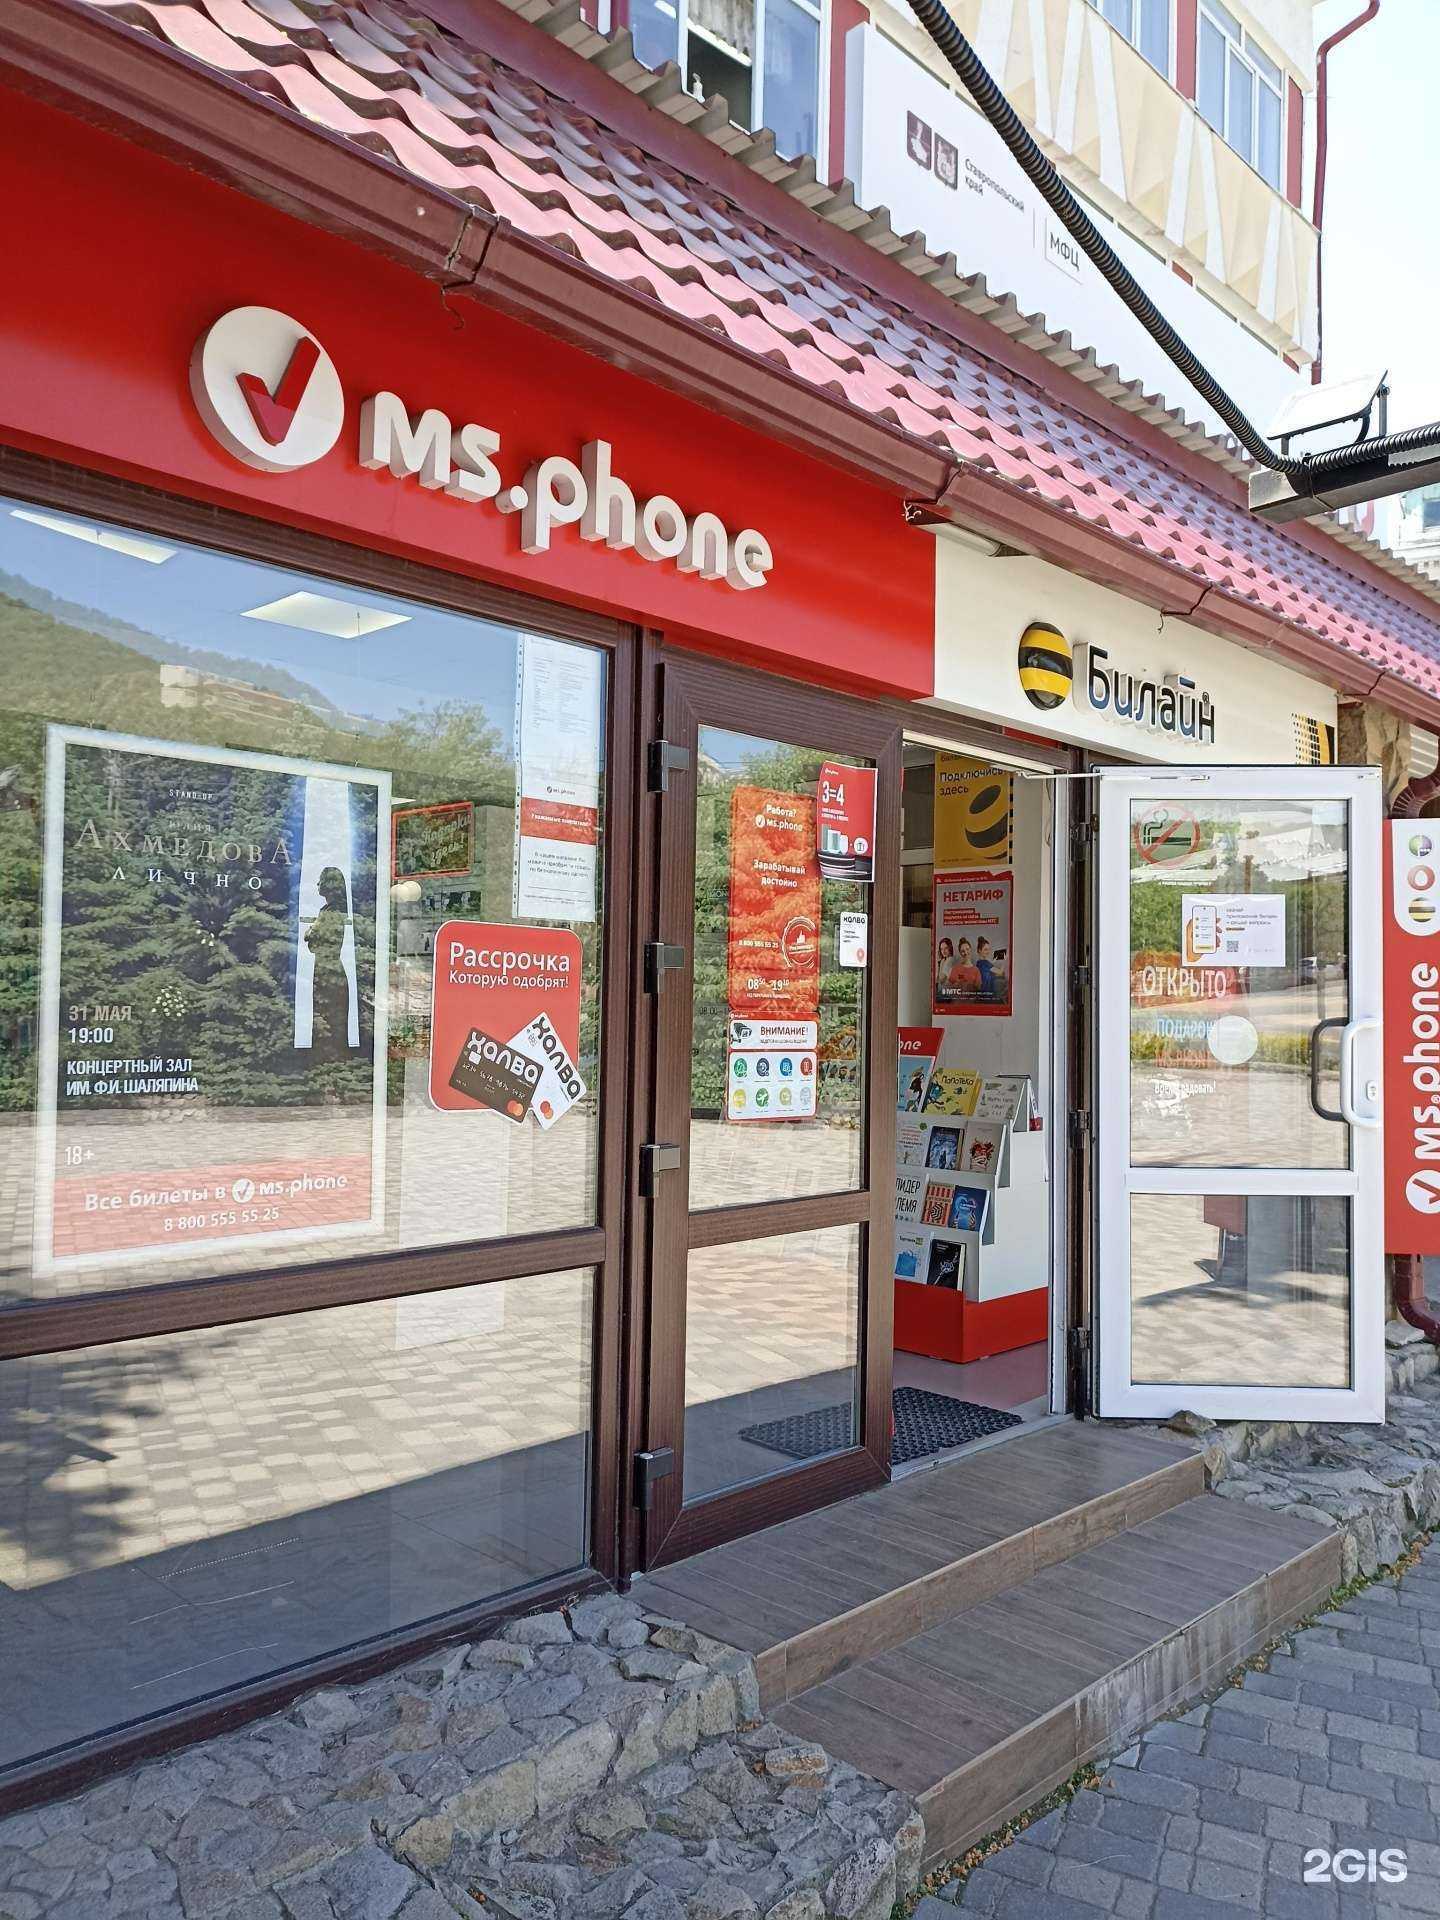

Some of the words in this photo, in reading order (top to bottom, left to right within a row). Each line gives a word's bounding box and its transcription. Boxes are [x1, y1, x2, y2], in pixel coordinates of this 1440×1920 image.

[1049, 232, 1080, 271] МФЦ
[169, 788, 213, 801] STAND-UP
[822, 780, 845, 807] 3=4
[939, 785, 969, 797] здесь
[766, 804, 797, 817] Работа?
[753, 859, 806, 875] Зарабатывай
[113, 866, 262, 891] ЛИЧНО
[943, 889, 1004, 902] НЕТАРИФ
[449, 941, 570, 975] Рассрочка
[449, 969, 509, 989] Которую
[513, 975, 570, 991] одобрят!
[1142, 965, 1227, 998] ОТКРЫТО
[68, 1005, 87, 1021] 31
[94, 1005, 132, 1021] МАЯ
[68, 1027, 114, 1044] 19:00
[760, 1026, 809, 1036] ВНИМАНИЕ!
[66, 1056, 163, 1076] КОНЦЕРТНЫЙ
[165, 1058, 193, 1073] ЗАЛ
[123, 1077, 199, 1094] ШАЛЯПИНА
[64, 1145, 95, 1165] 18+
[84, 1193, 122, 1212] Все
[128, 1188, 209, 1209] билеты
[214, 1188, 226, 1200] в
[163, 1217, 173, 1232] 8
[177, 1214, 206, 1230] 800
[210, 1210, 237, 1226] 555
[241, 1209, 259, 1224] 55
[261, 1207, 280, 1221] 25
